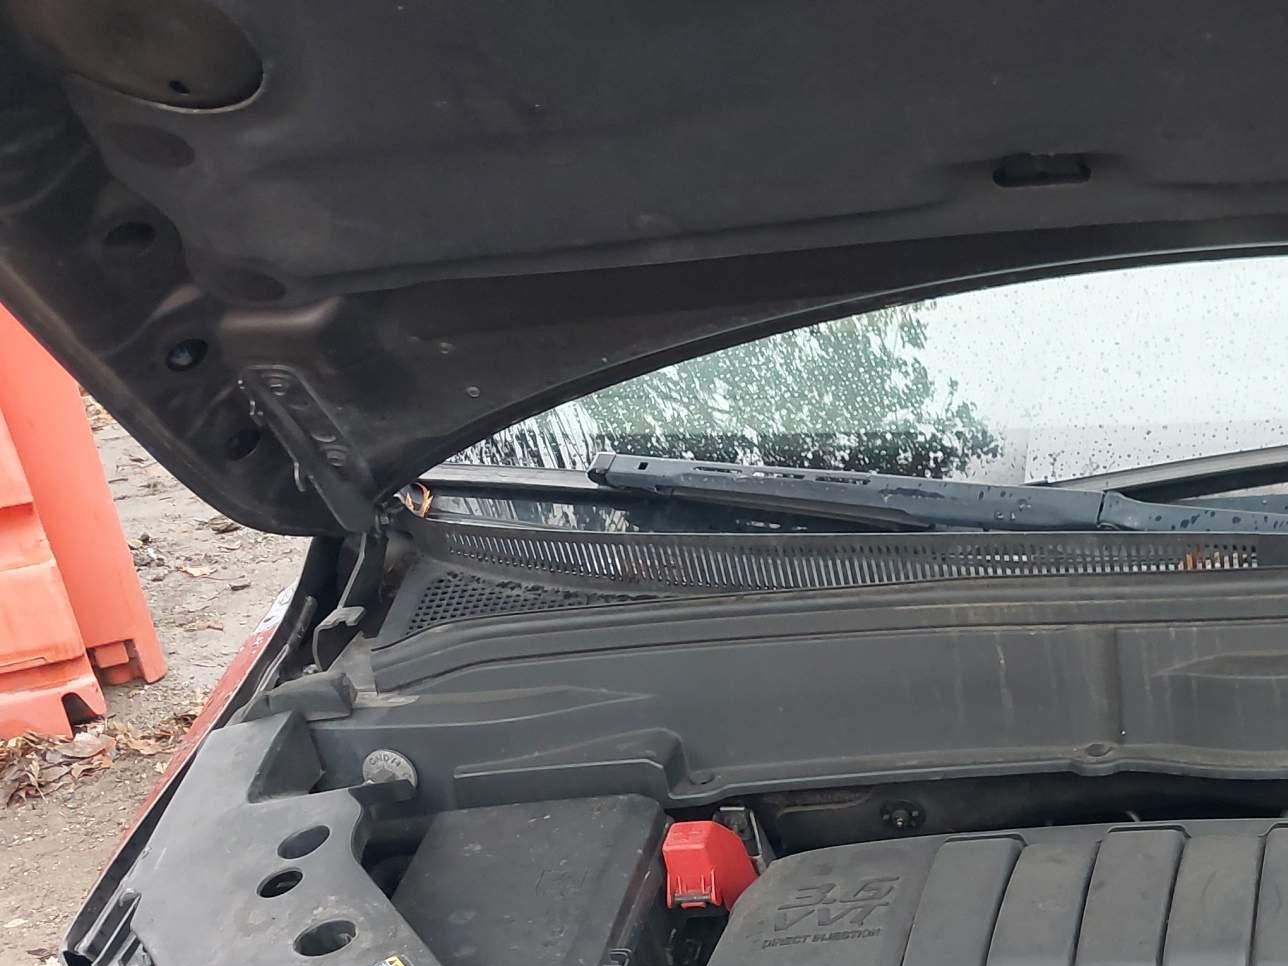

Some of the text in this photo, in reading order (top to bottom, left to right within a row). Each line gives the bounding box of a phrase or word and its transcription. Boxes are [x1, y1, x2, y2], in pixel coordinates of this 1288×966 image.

[777, 876, 900, 911] 3.6
[774, 902, 890, 932] VVT
[761, 928, 881, 950] DIRECT INJECTION
